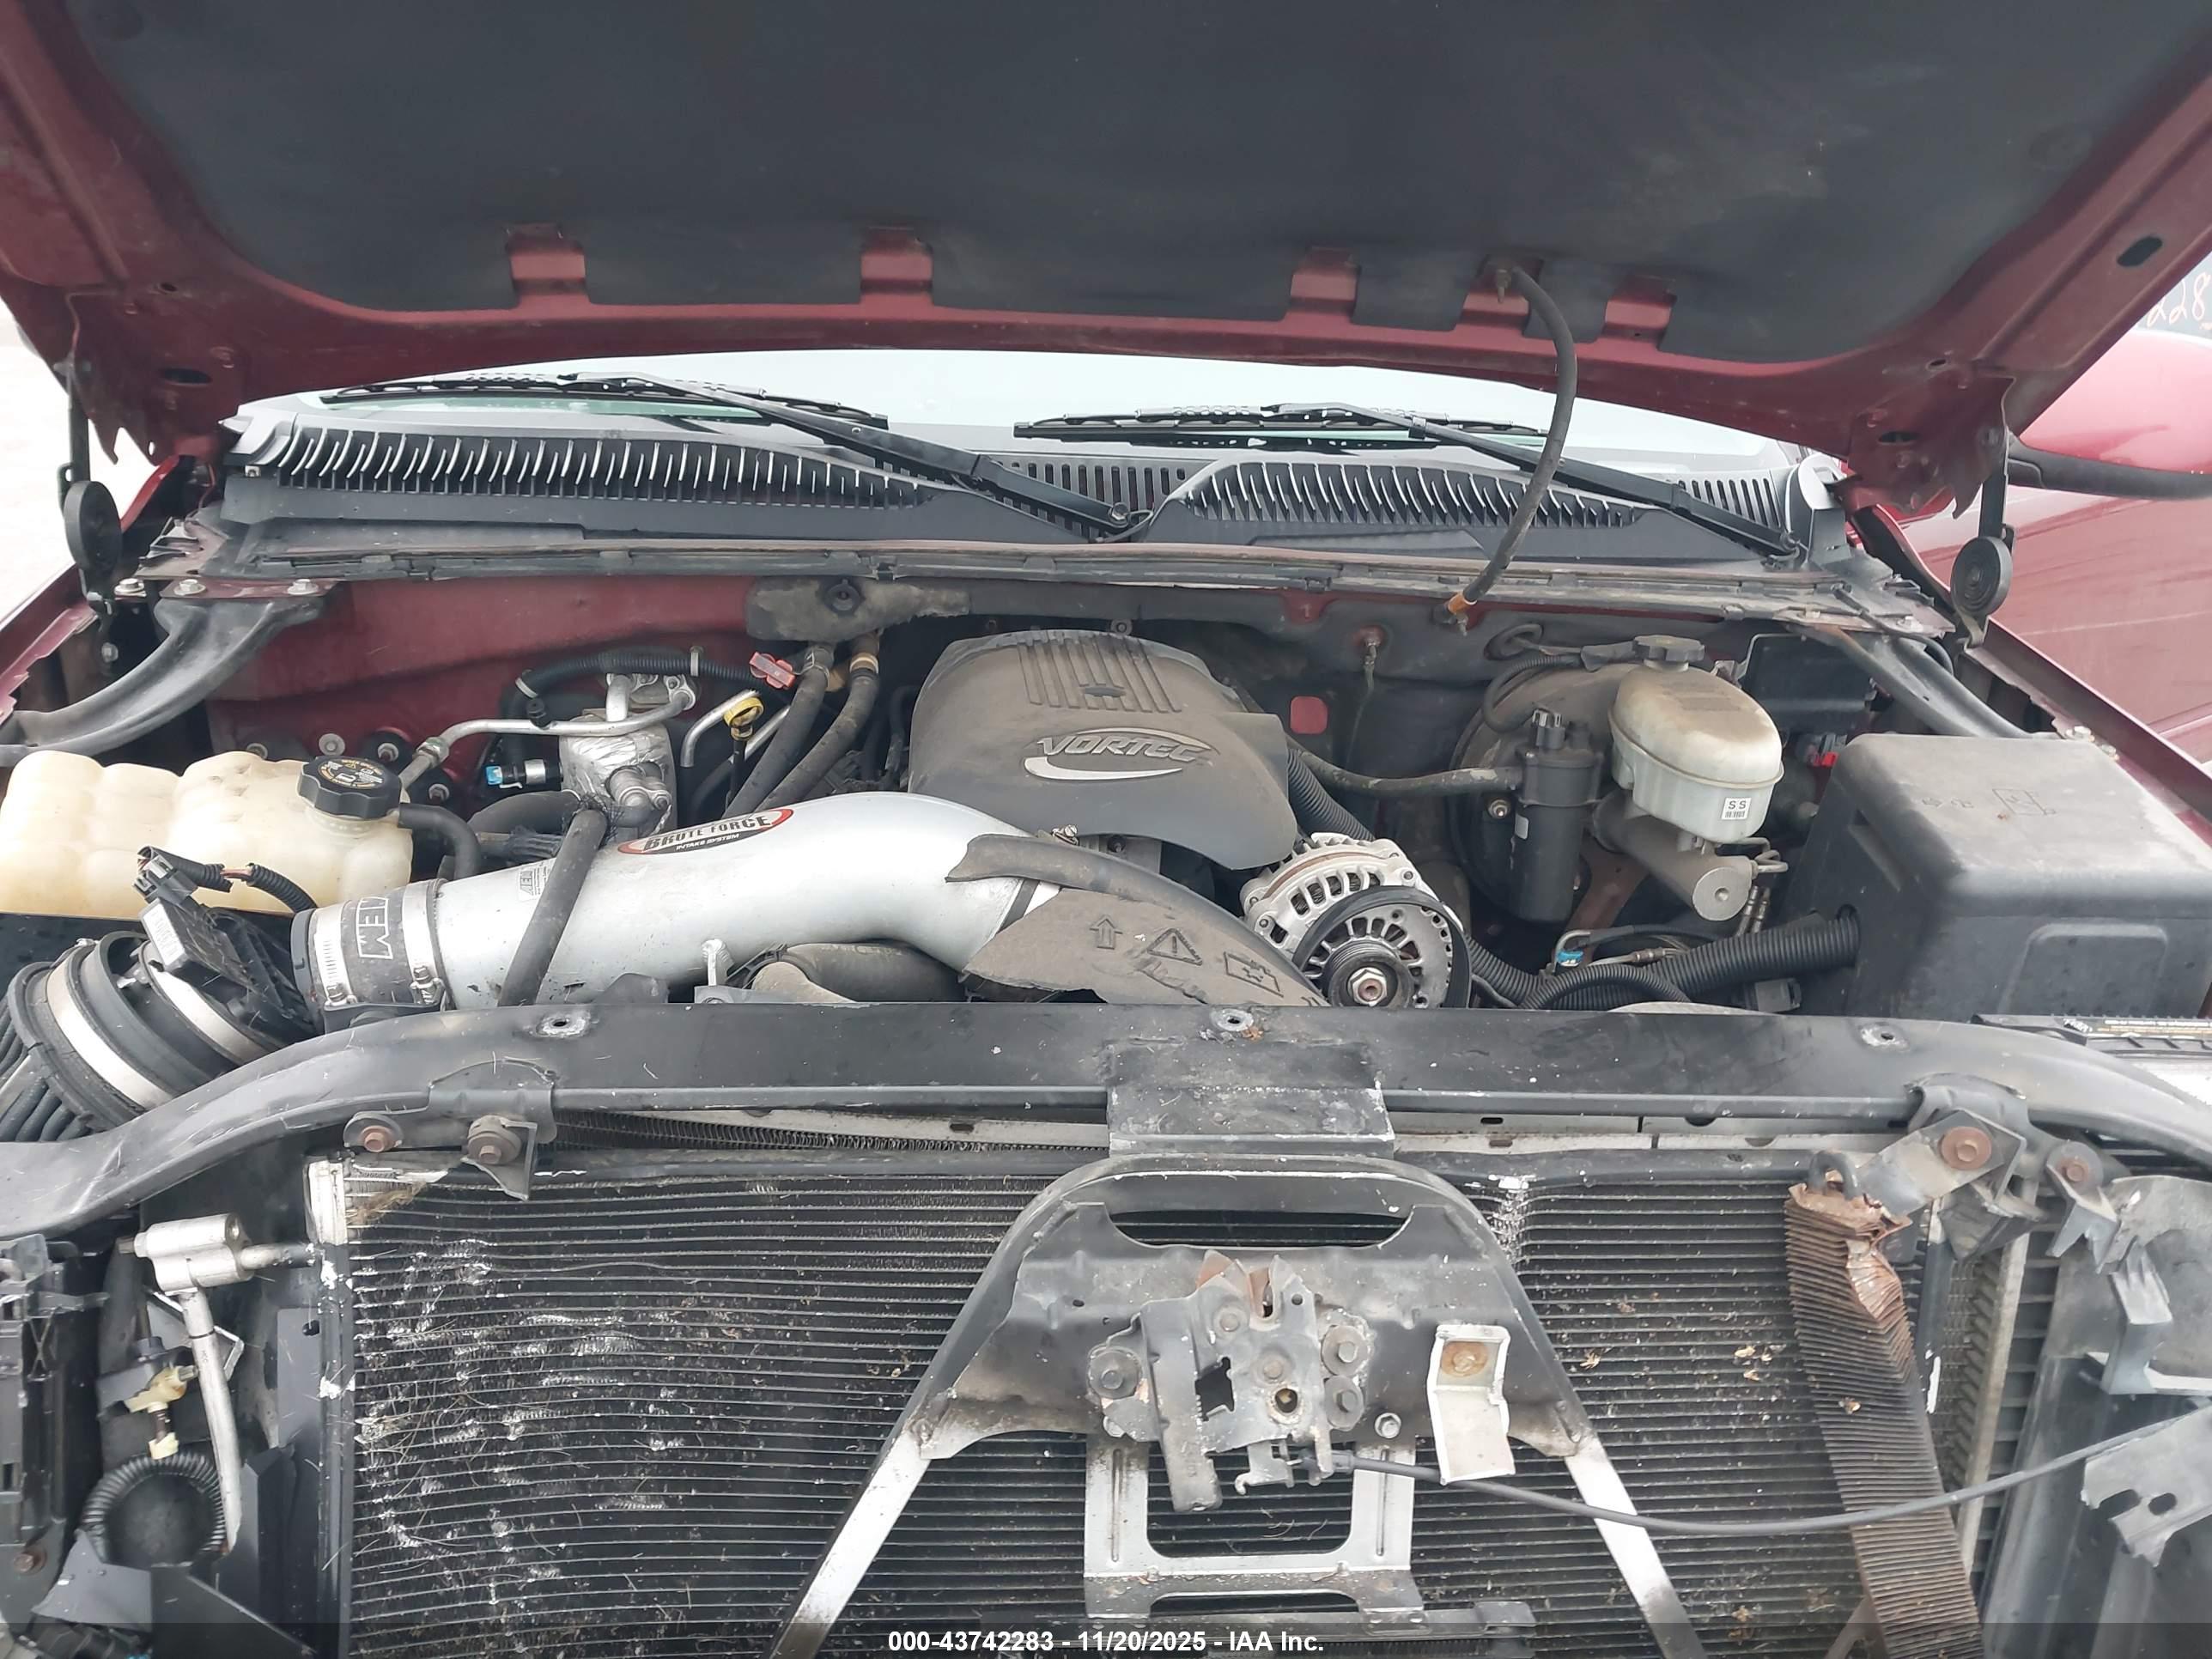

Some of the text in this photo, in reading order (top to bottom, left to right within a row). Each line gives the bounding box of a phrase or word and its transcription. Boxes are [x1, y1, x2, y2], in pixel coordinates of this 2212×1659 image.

[1036, 735, 1200, 763] VORTEC
[645, 816, 771, 849] BRUTE FORCE
[676, 834, 740, 850] INTAKE SYSTEM
